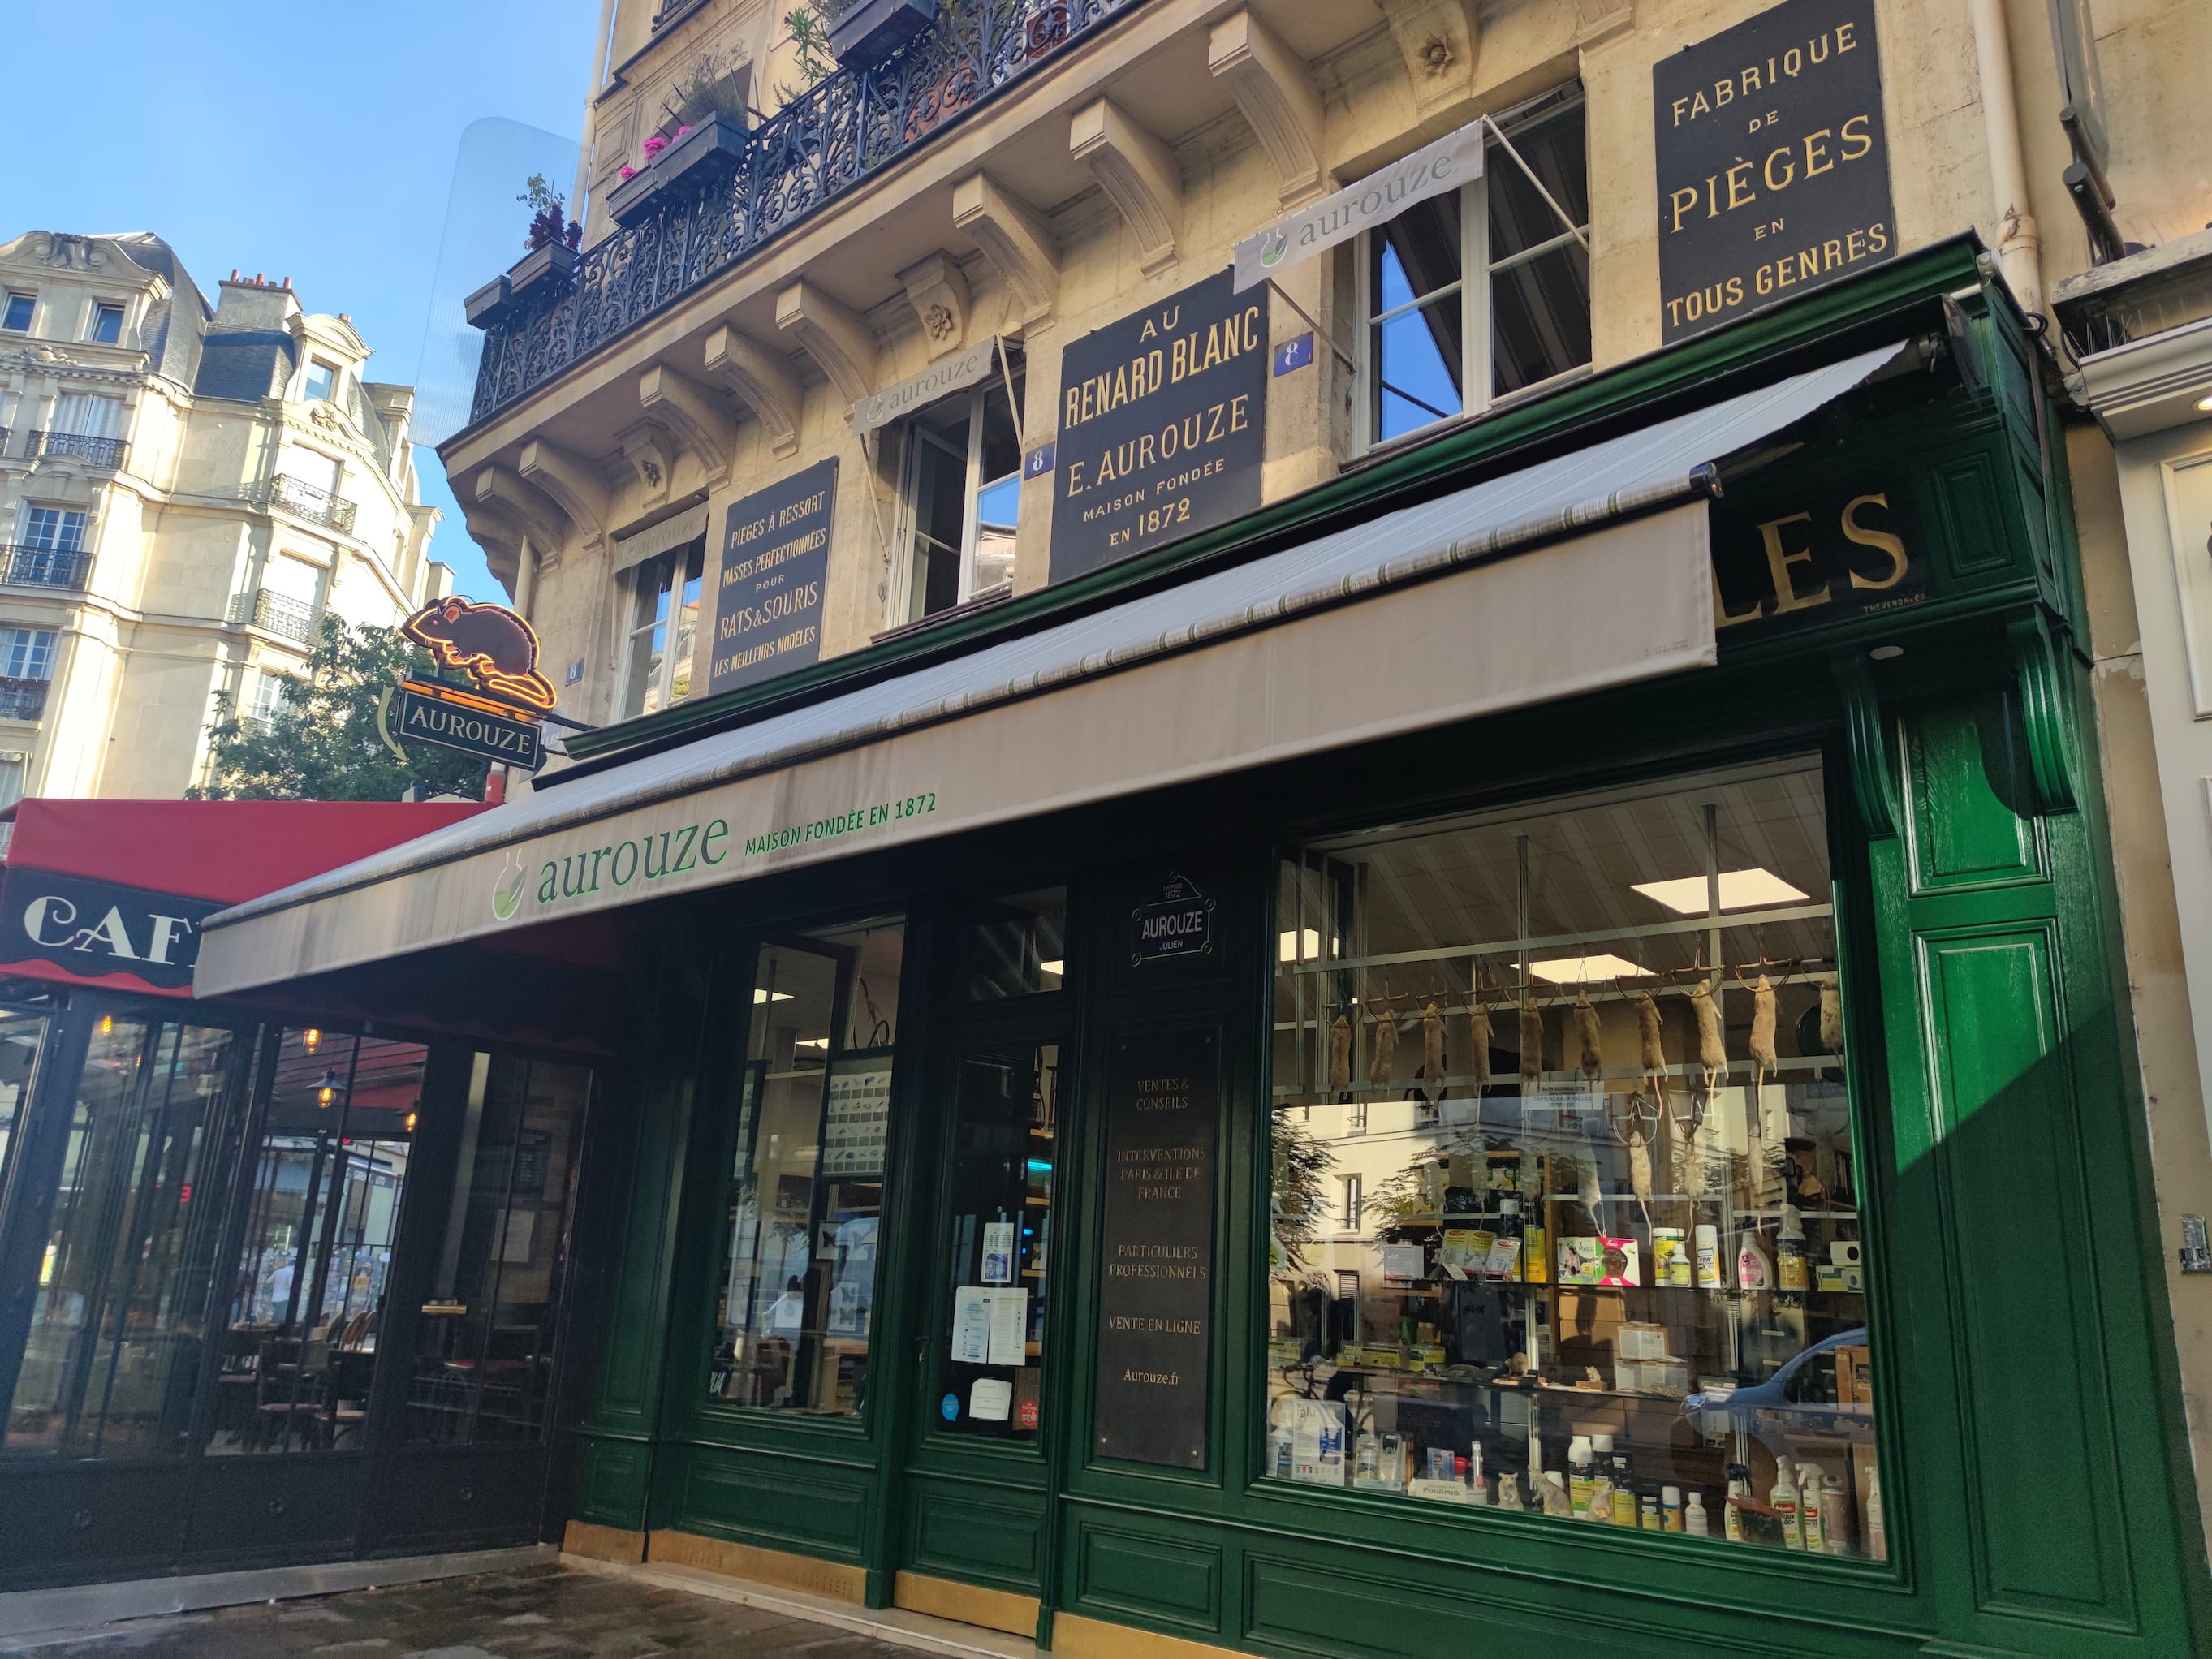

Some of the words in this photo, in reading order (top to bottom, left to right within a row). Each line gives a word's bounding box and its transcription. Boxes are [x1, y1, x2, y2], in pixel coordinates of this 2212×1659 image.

[1672, 22, 1857, 127] FABRIQUE
[1748, 110, 1779, 134] DE
[1669, 114, 1874, 234] PIÈGES
[1300, 155, 1452, 247] aurouze
[1754, 218, 1784, 242] EN
[1667, 277, 1744, 327] TOUS
[1139, 305, 1180, 344] AU
[1284, 341, 1299, 366] 8
[1065, 349, 1162, 429] RENARD
[1171, 306, 1259, 384] BLANC
[890, 356, 977, 409] aurouze
[1067, 460, 1092, 498] E.
[1096, 394, 1248, 486] AUROUZE
[1033, 450, 1043, 471] 8
[1084, 489, 1145, 523] MAISON
[1156, 458, 1225, 494] FONDÉE
[731, 518, 765, 549] PIÈGES
[768, 511, 776, 532] À
[778, 490, 826, 528] RESSORT
[1110, 528, 1130, 547] EN
[1139, 498, 1191, 536] 1872
[722, 560, 754, 588] NASSES
[755, 574, 785, 593] POUR
[570, 662, 576, 679] 8
[714, 658, 729, 678] LES
[731, 641, 774, 671] MEILLEURS
[409, 706, 531, 755] AUROUZE
[537, 818, 729, 903] aurouze
[744, 827, 801, 857] MAISON
[804, 809, 865, 843] FONDÉE
[868, 803, 889, 824] EN
[894, 792, 937, 820] 1872
[1165, 890, 1181, 900] 1872
[24, 895, 196, 968] CAF
[1142, 910, 1203, 940] AUROUZE
[1159, 939, 1184, 950] JULIEN
[1137, 1079, 1179, 1092] VENTES
[1181, 1078, 1188, 1090] &
[1136, 1097, 1188, 1110] CONSEILS
[1117, 1148, 1206, 1162] INTERVENTIONS
[1121, 1168, 1151, 1181] PARIS
[1185, 1167, 1201, 1179] DE
[1138, 1187, 1182, 1200] FRANCE
[1118, 1244, 1198, 1259] PARTICULIERS
[1110, 1264, 1206, 1280] PROFESSIONNELS
[1109, 1316, 1145, 1331] VENTE
[1148, 1318, 1162, 1331] EN
[1166, 1319, 1201, 1334] LIGNE
[1123, 1368, 1180, 1385] Aurouze.fr
